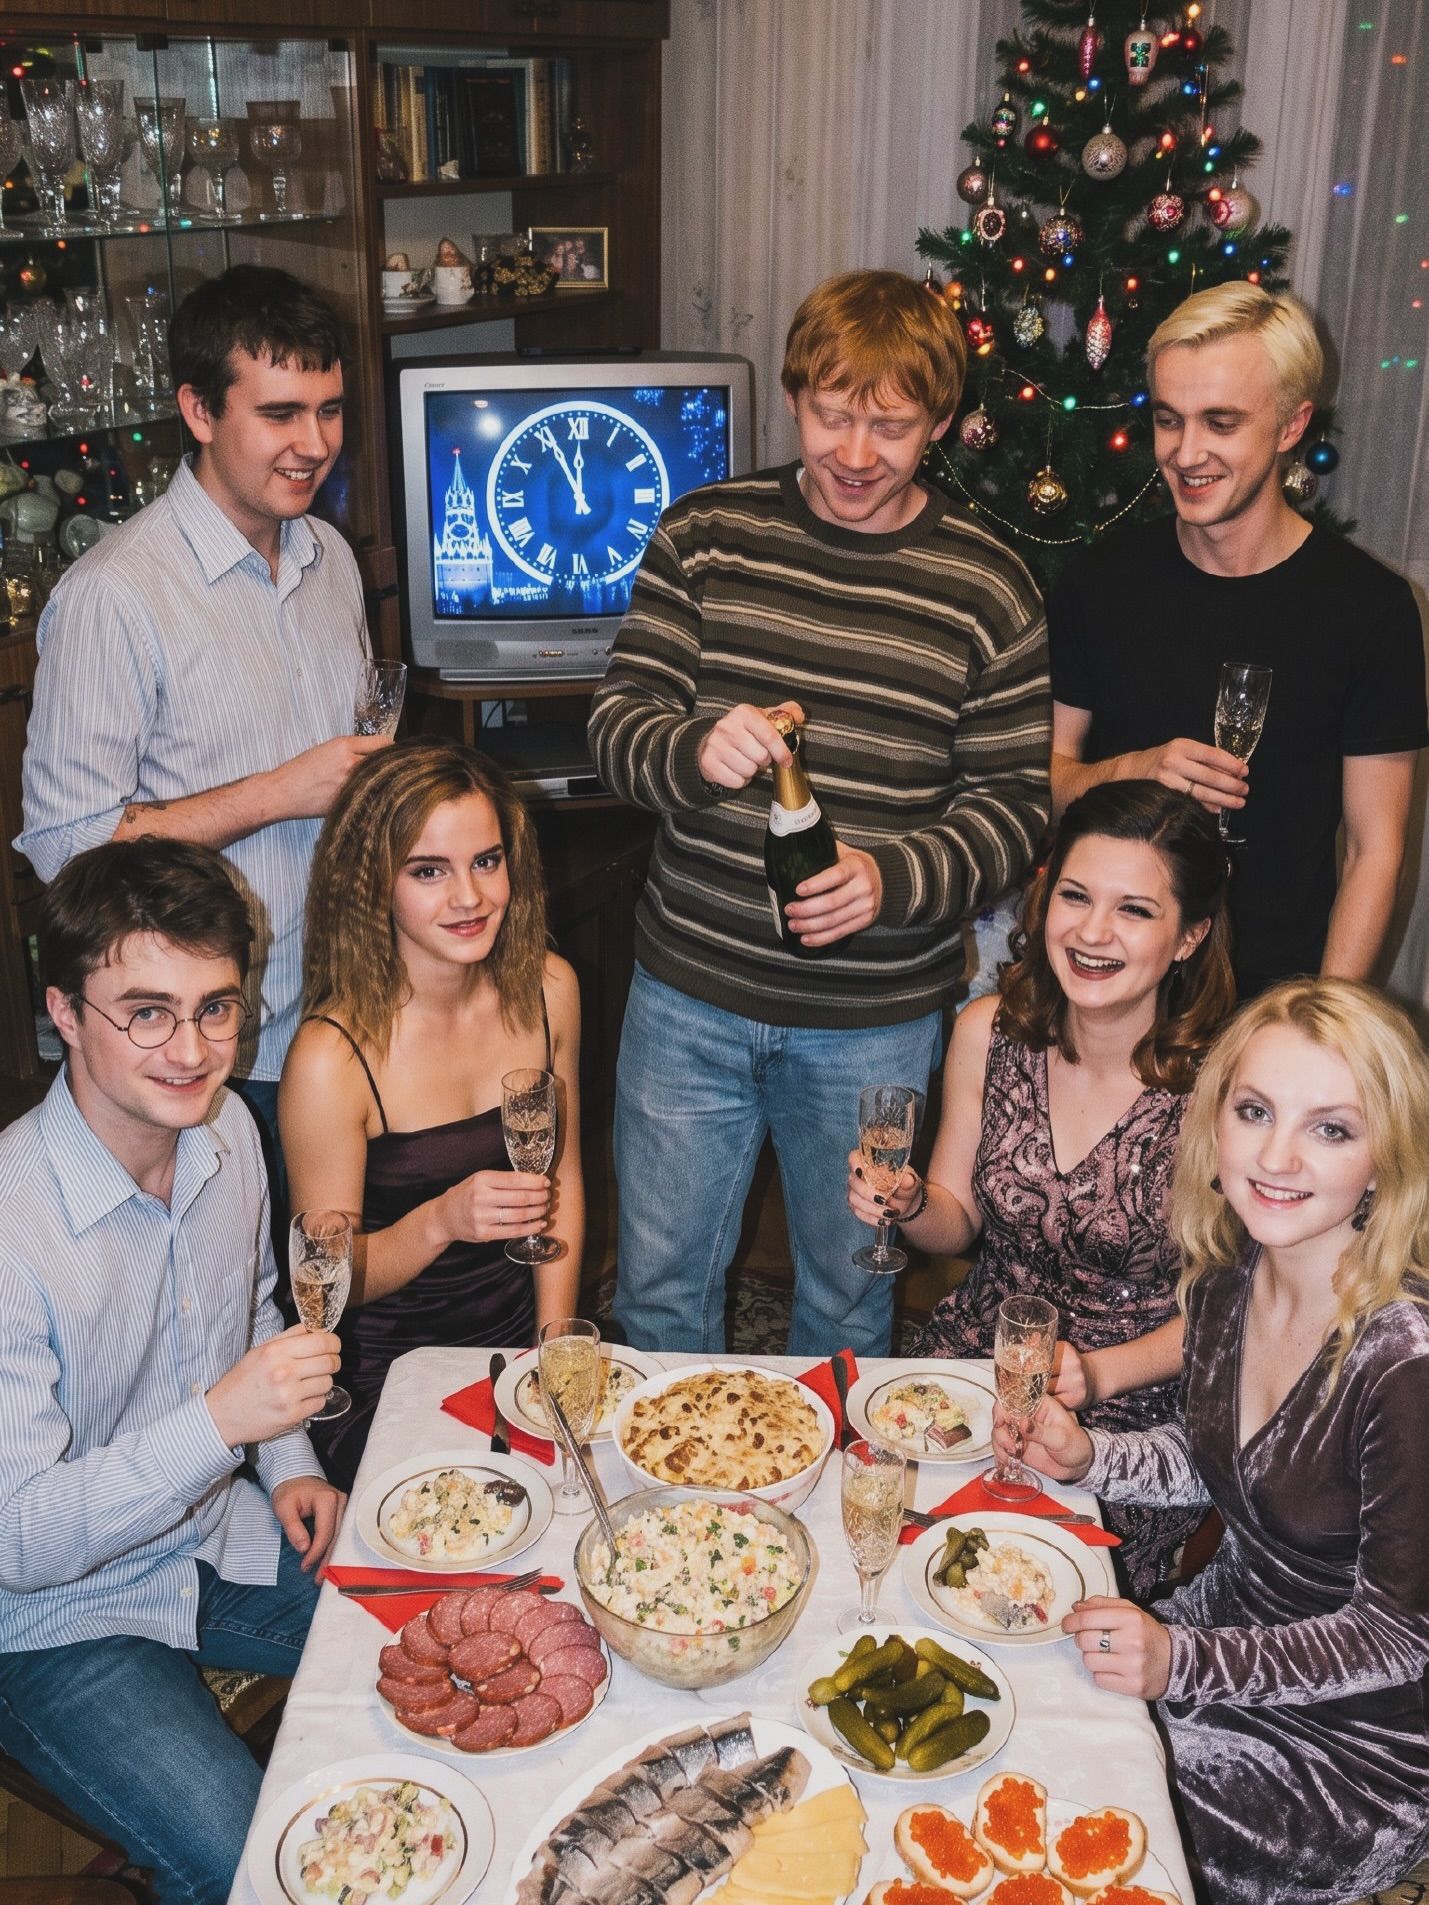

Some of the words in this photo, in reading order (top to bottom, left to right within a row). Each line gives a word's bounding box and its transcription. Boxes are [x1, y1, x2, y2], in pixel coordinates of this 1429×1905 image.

[567, 417, 589, 440] XII
[510, 453, 532, 476] X
[502, 489, 524, 508] IX
[626, 518, 649, 540] IV
[572, 553, 589, 574] VI
[607, 545, 622, 566] V
